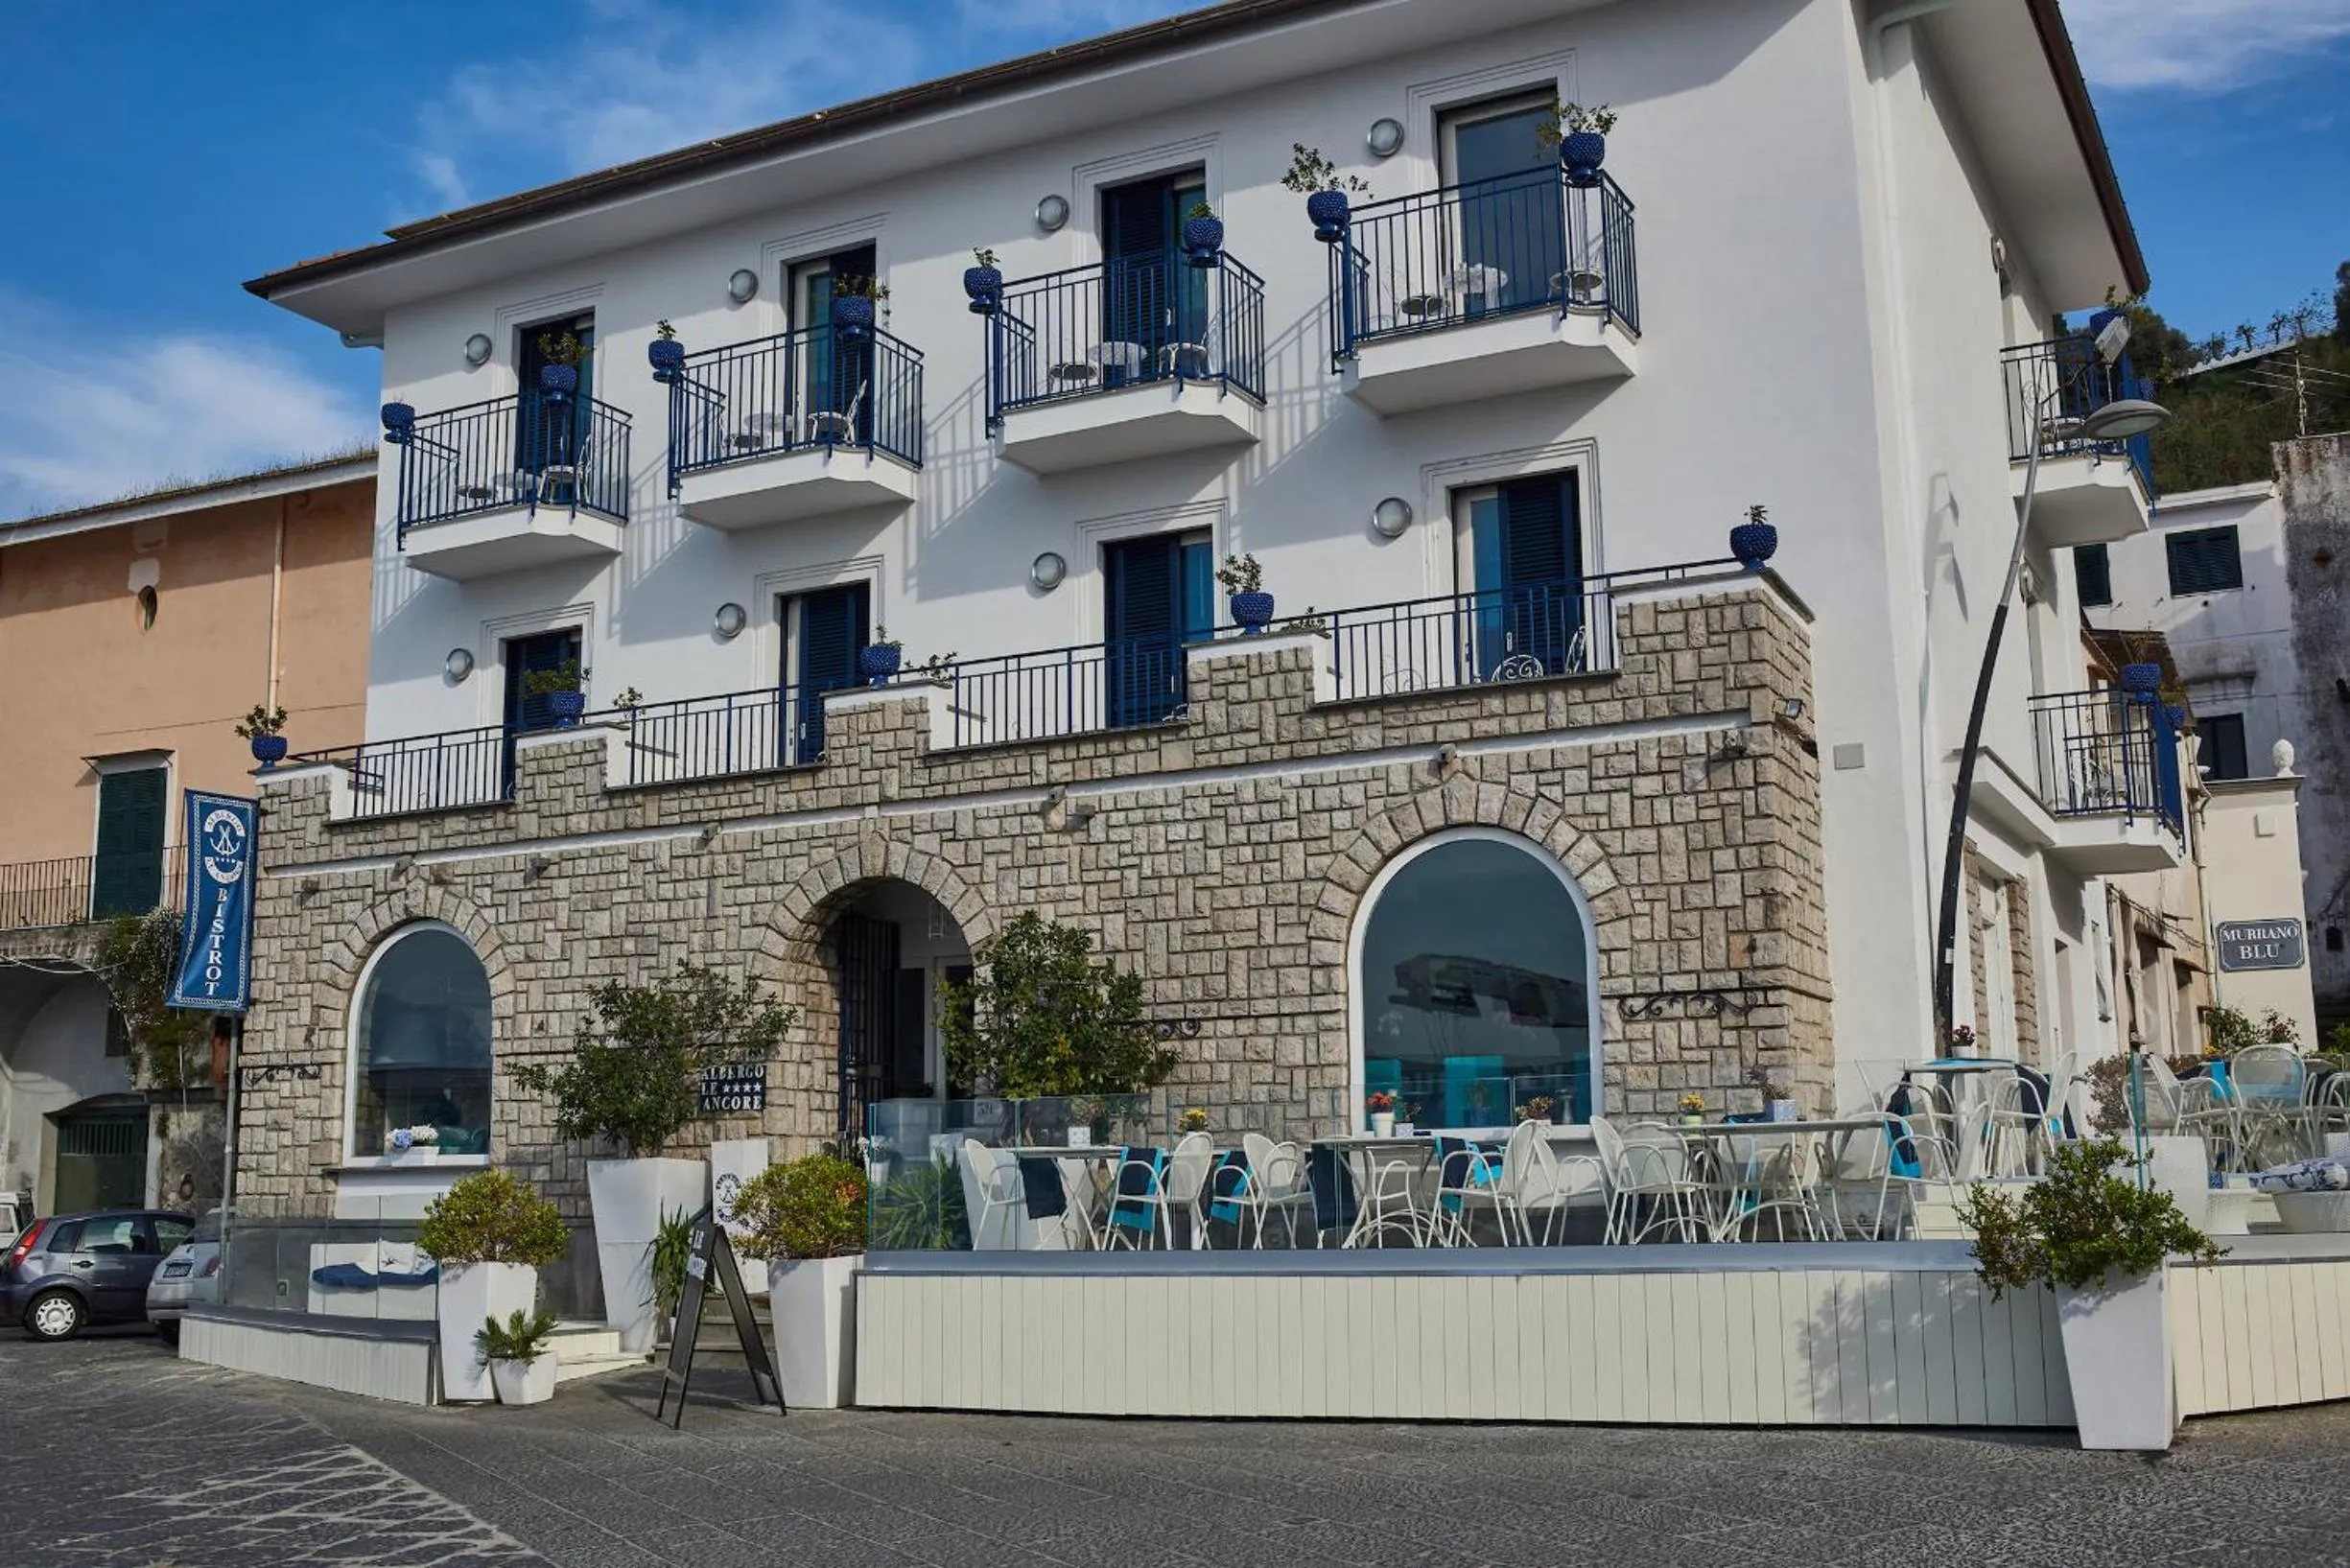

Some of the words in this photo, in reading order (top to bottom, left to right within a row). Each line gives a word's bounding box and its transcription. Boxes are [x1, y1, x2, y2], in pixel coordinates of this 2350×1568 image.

[205, 888, 227, 995] BISTROT
[2239, 944, 2280, 959] BLU
[701, 1065, 764, 1080] ALBERGO
[701, 1082, 717, 1095] LE
[703, 1096, 763, 1111] ANCORE
